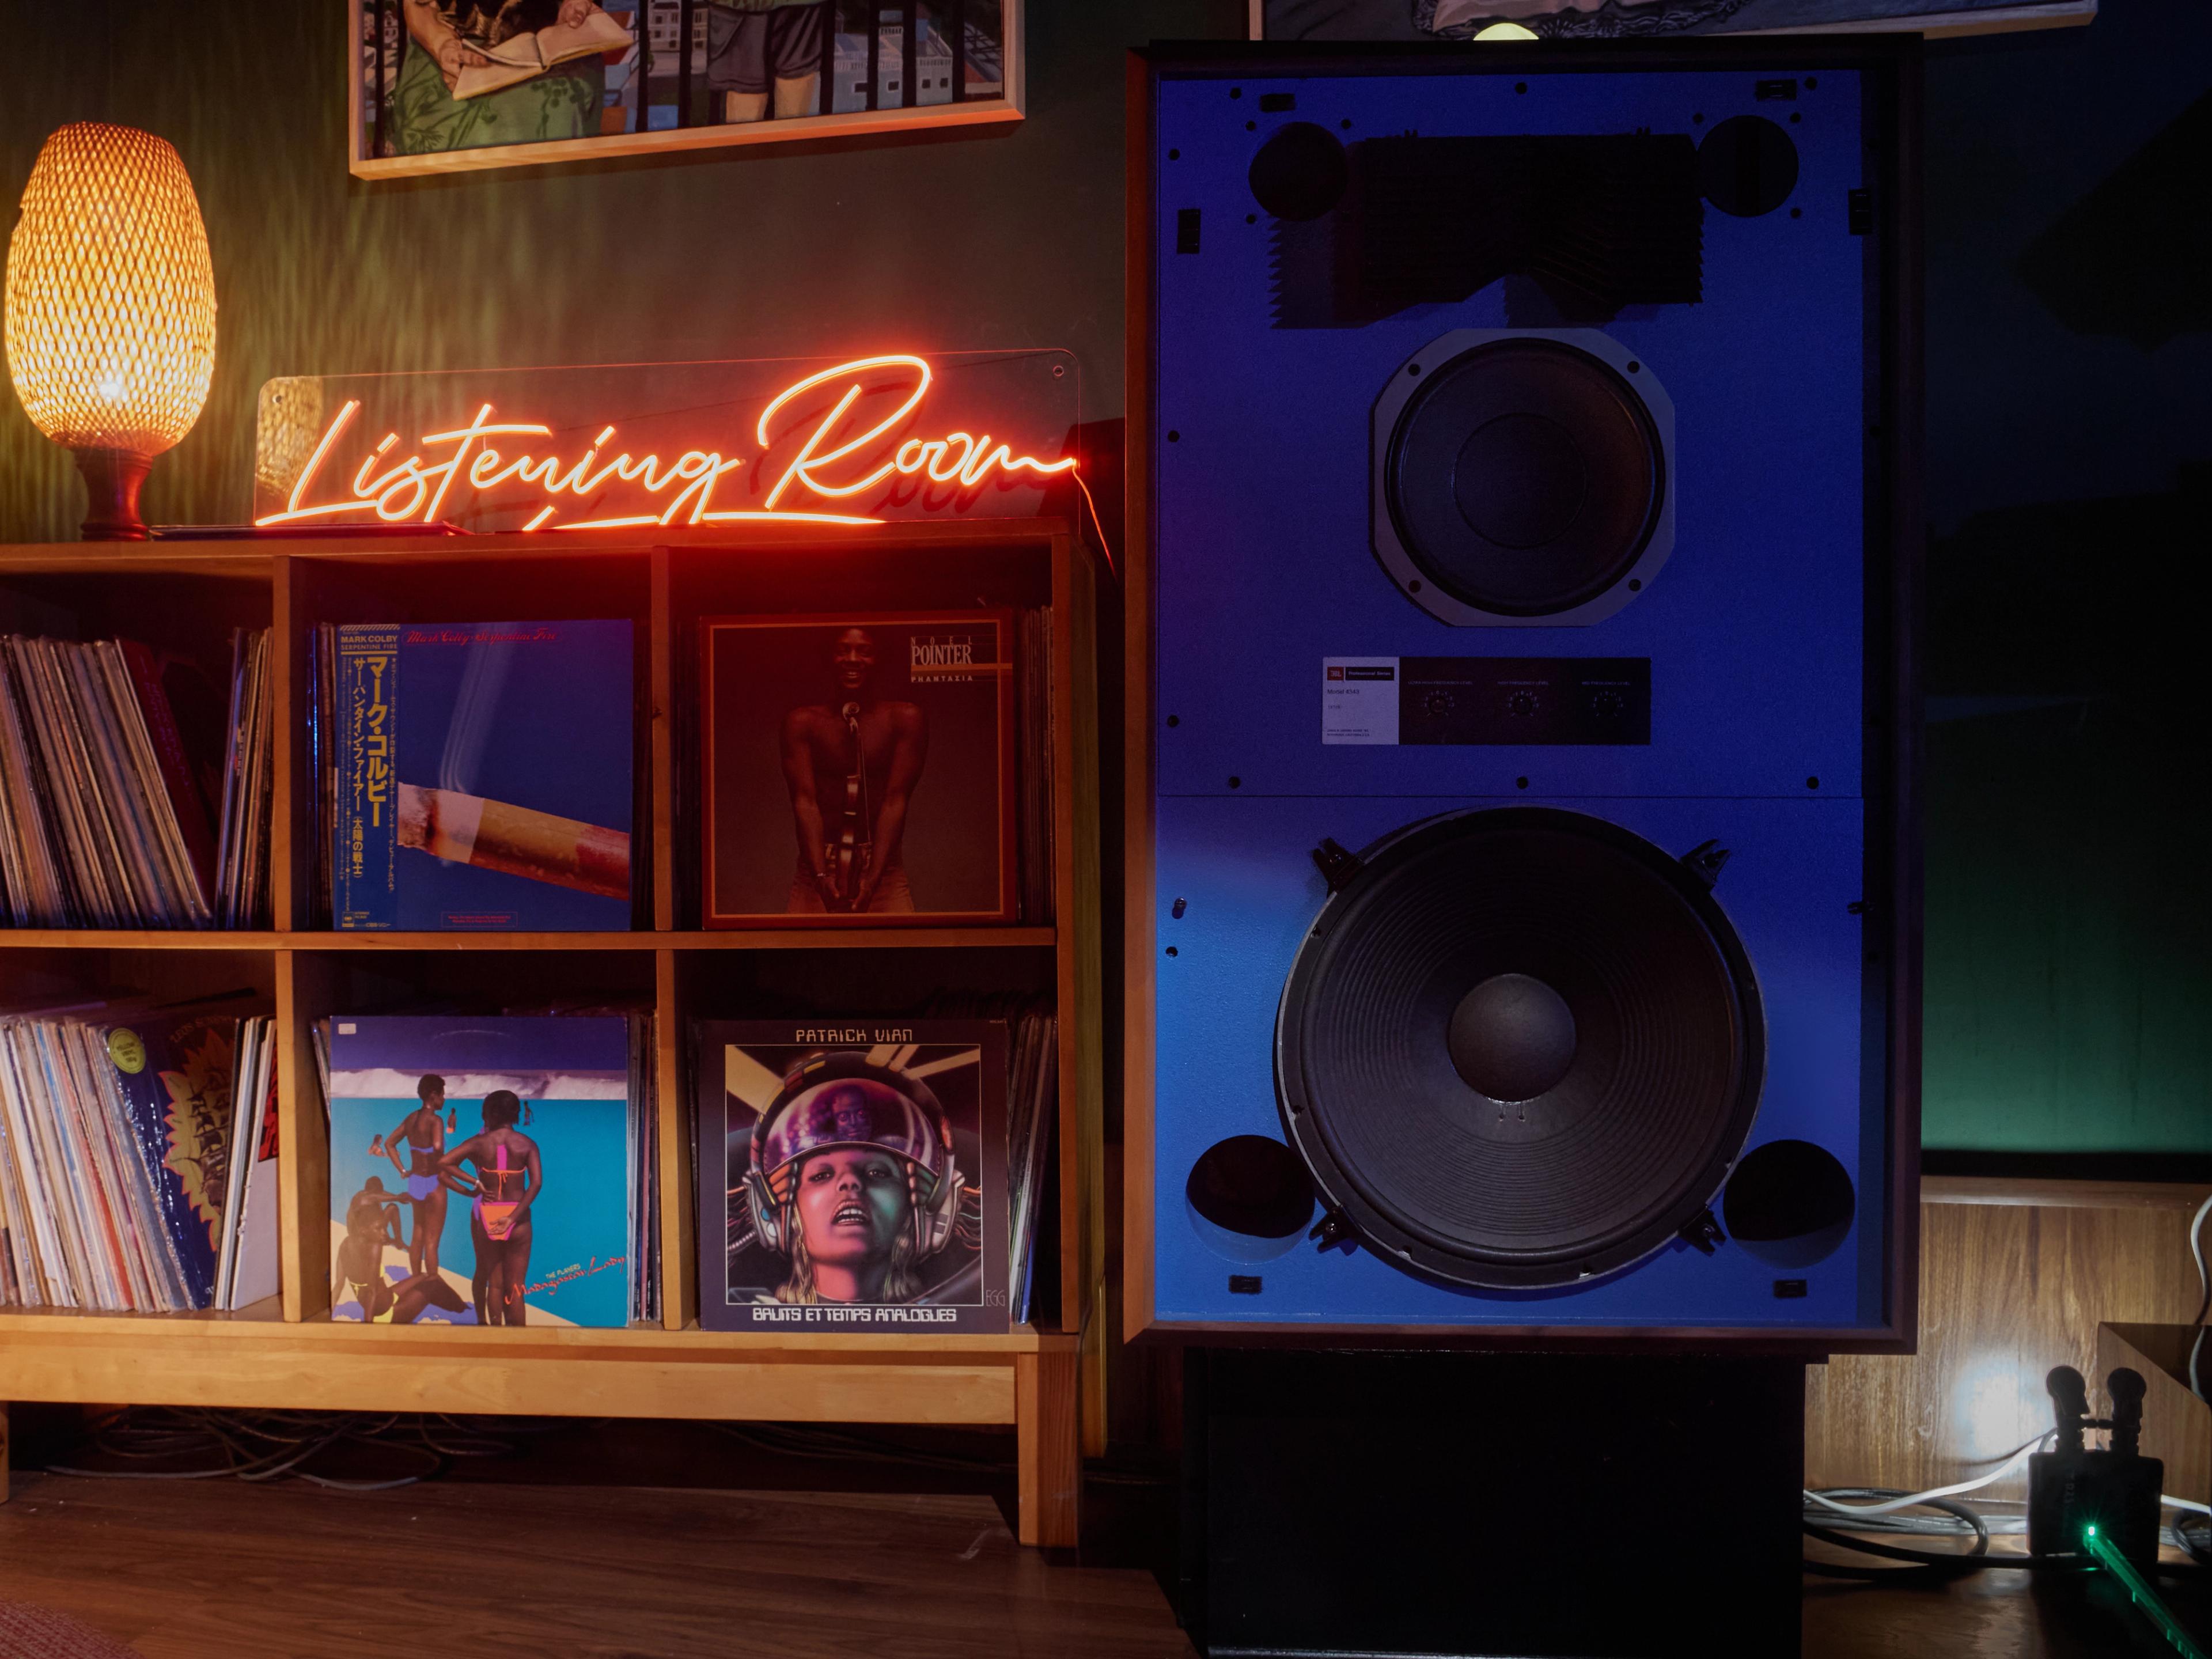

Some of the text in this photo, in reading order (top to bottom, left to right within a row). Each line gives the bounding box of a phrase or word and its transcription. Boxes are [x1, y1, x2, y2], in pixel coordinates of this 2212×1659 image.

[255, 355, 1075, 532] Listening Room
[368, 635, 397, 643] COLBY
[910, 644, 973, 665] POINTER
[366, 656, 389, 827] マーク・コルビー
[796, 1029, 912, 1042] PATRICK VIAN
[546, 1263, 581, 1279] THE PLAYERS
[587, 1256, 626, 1277] Lady
[985, 1289, 1006, 1307] EGG
[752, 1308, 957, 1322] BRUITS ET TEMPS ANALOGUES
